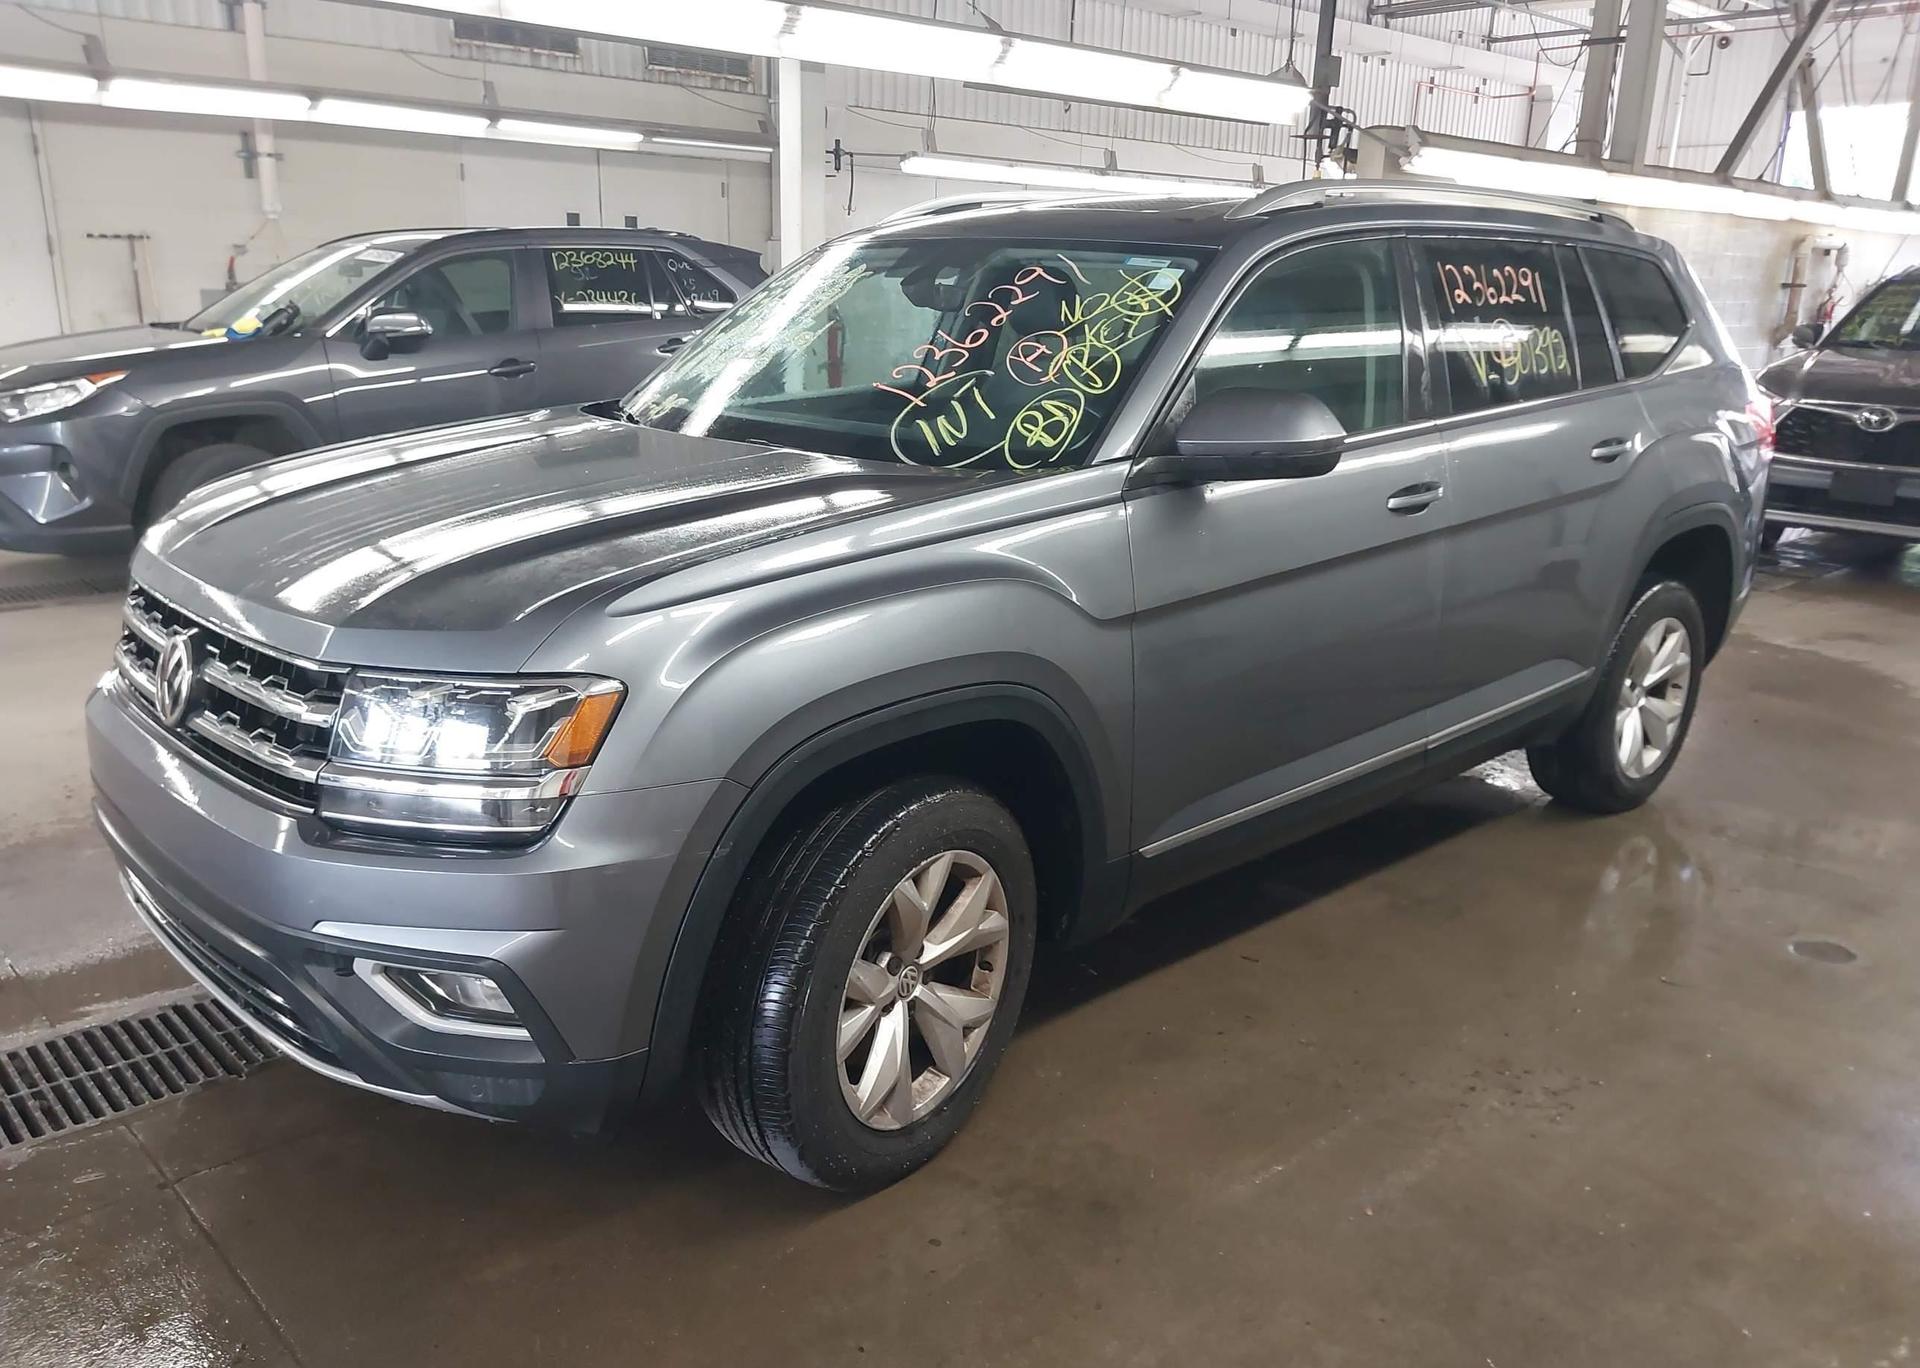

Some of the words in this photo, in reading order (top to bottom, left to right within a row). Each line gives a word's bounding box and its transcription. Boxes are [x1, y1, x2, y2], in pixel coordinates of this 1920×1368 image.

[552, 251, 638, 272] 12368244
[1437, 261, 1548, 314] 12362291
[873, 253, 1091, 407] 12362291
[1060, 292, 1111, 321] NO
[916, 378, 996, 456] INT
